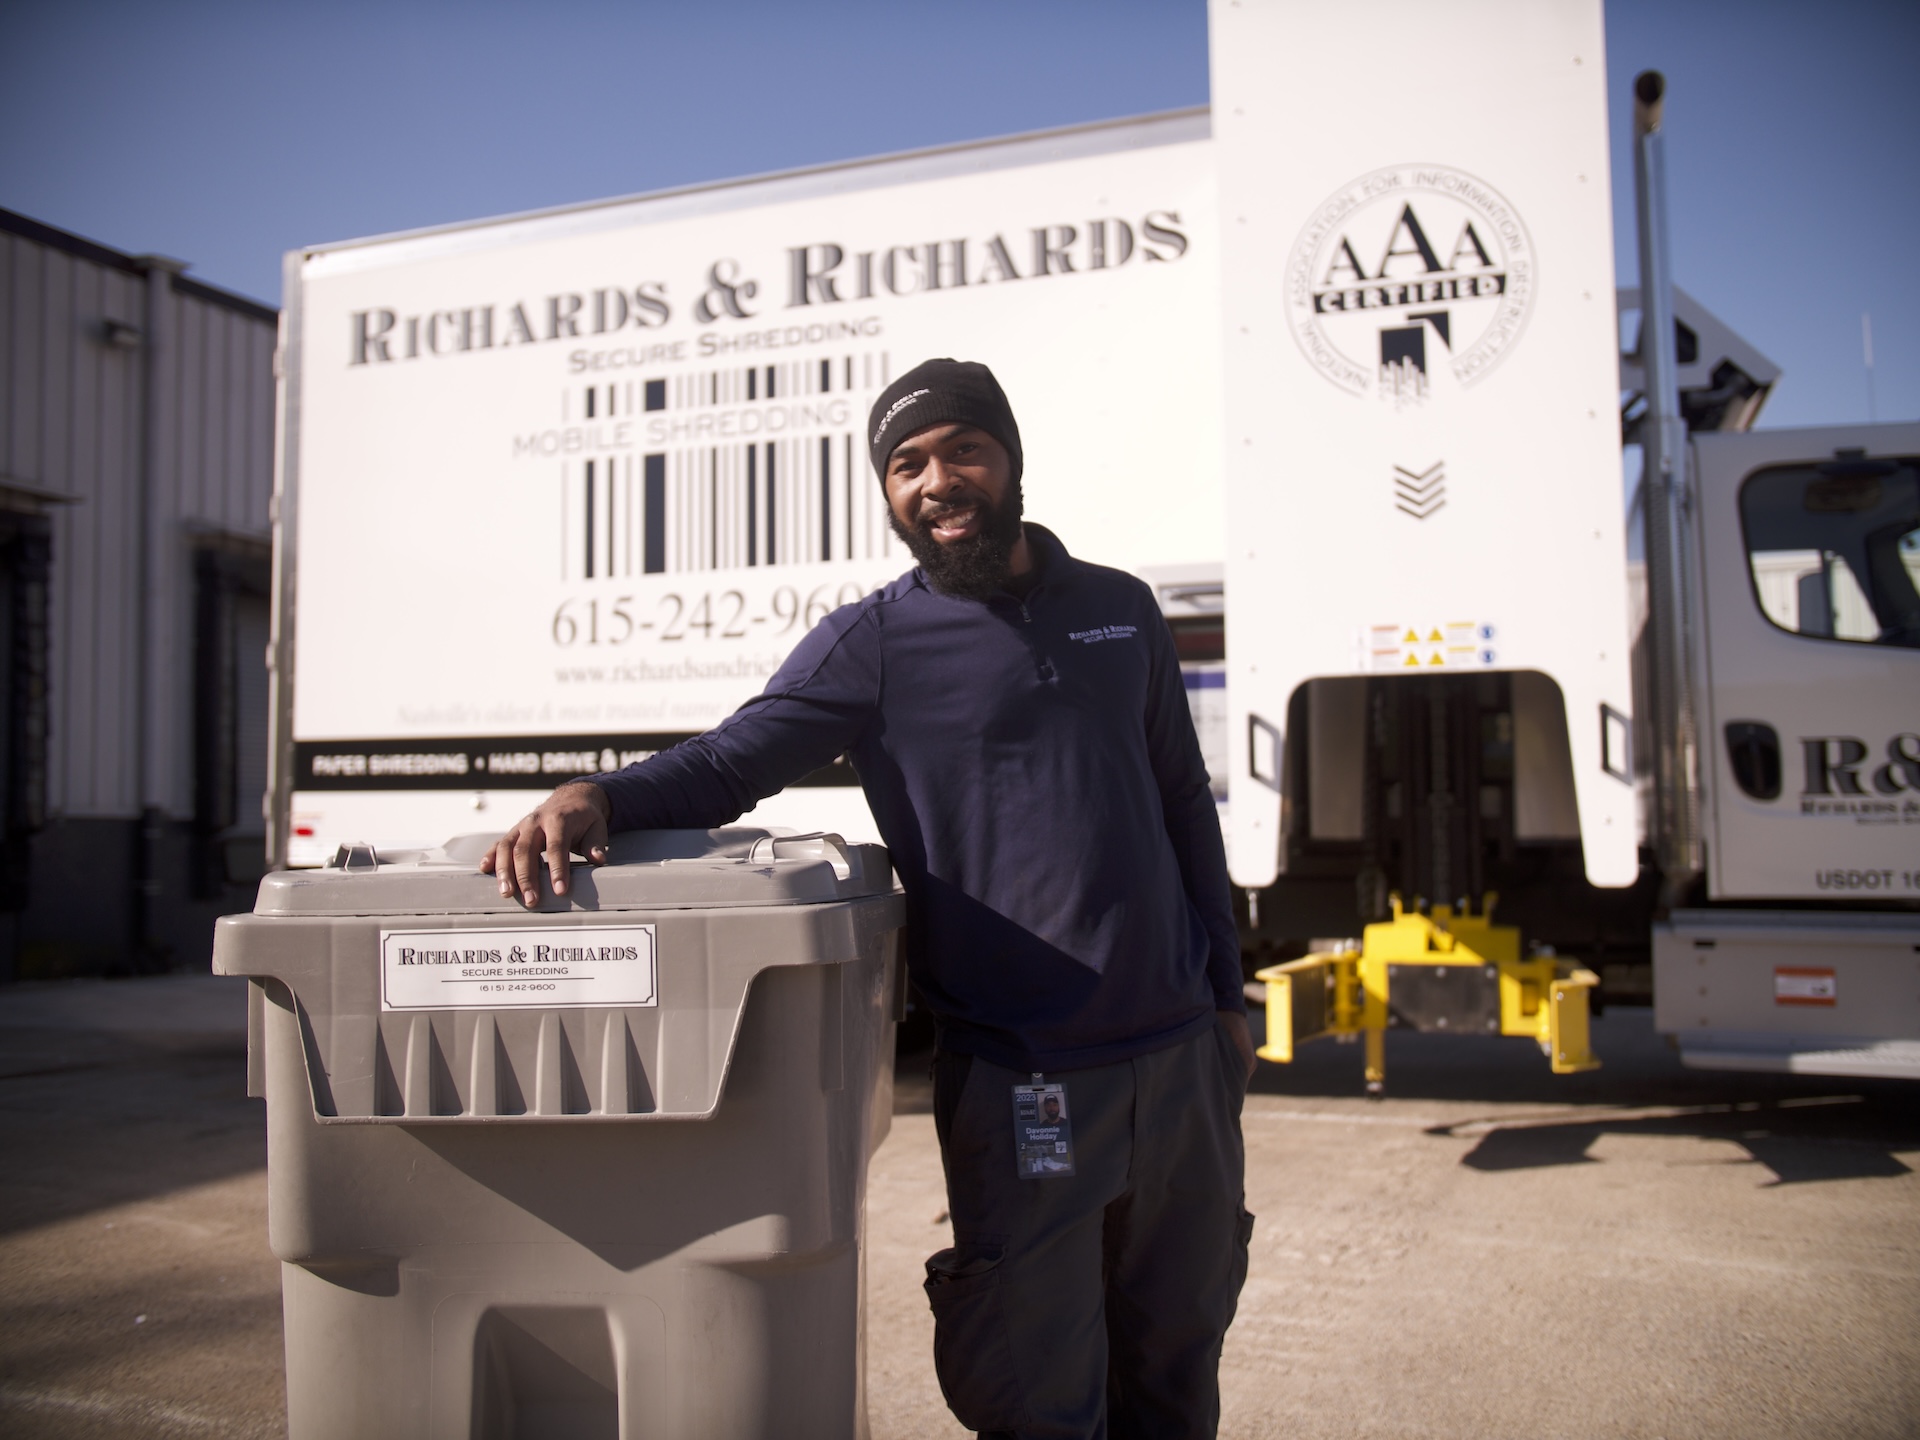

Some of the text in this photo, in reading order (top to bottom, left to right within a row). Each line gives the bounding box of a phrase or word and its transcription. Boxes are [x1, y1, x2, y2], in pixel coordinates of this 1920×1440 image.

[346, 209, 1190, 367] RICHARDS & RICHARDS
[1319, 275, 1501, 313] CERTIFIED
[568, 316, 883, 375] SECURE SHREDDING
[512, 421, 634, 459] MOBILE
[645, 399, 851, 446] SHREDDING
[1815, 868, 1894, 890] USDOT
[398, 944, 638, 966] RICHARDS & RICHARDS
[462, 967, 569, 977] SECURE SHREDDING
[480, 983, 555, 992] (615) 242-9600
[1017, 1094, 1036, 1102] 2023
